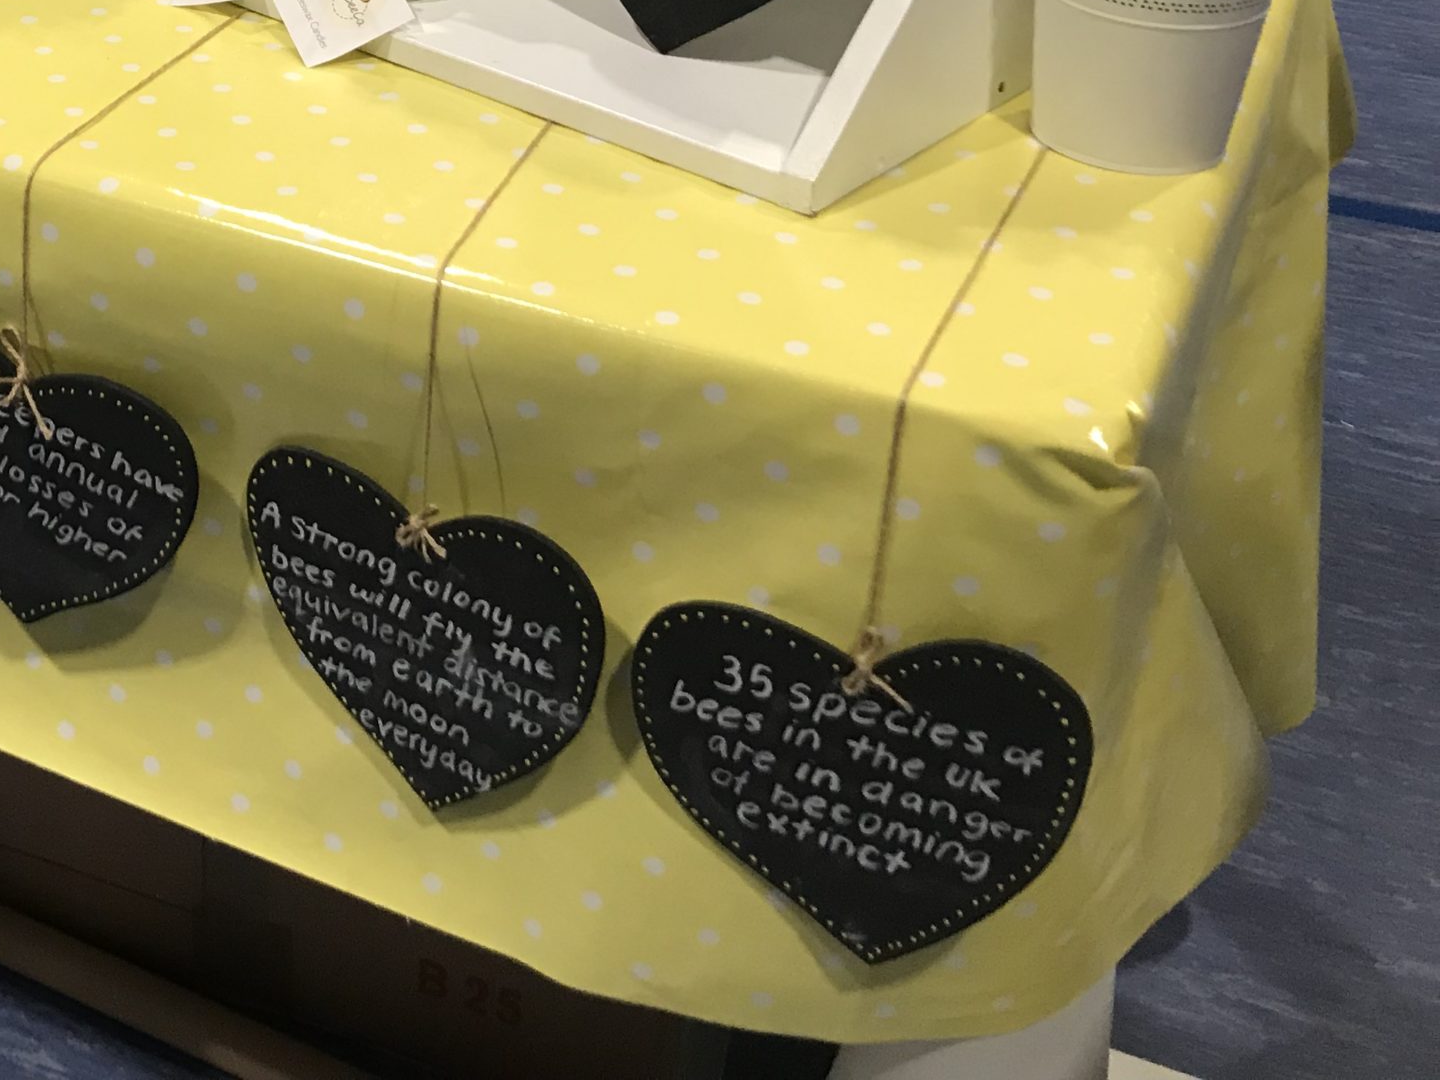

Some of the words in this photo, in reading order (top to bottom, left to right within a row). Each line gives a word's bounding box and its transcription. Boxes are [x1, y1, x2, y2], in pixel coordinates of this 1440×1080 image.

[28, 442, 139, 510] annual
[106, 516, 144, 542] of
[111, 450, 184, 503] have
[27, 501, 128, 565] higher
[260, 500, 281, 530] A
[289, 514, 398, 587] strong
[407, 570, 513, 638] colony
[522, 620, 562, 651] of
[271, 543, 336, 589] bees
[349, 581, 412, 620] will
[422, 611, 474, 662] fly
[491, 639, 557, 680] the
[272, 574, 435, 660] equivalent
[442, 649, 581, 728] distance
[306, 615, 377, 668] from
[391, 657, 494, 721] earth
[507, 707, 544, 739] to
[319, 656, 373, 694] the
[383, 688, 470, 747] moon
[712, 653, 774, 699] 35
[788, 681, 990, 756] species
[1002, 742, 1045, 776] of
[669, 678, 765, 733] bees
[781, 718, 822, 751] in
[845, 734, 927, 780] the
[944, 761, 1003, 803] UK
[706, 733, 777, 773] are
[794, 757, 842, 793] in
[861, 777, 1034, 842] danger
[710, 766, 752, 796] of
[770, 782, 993, 883] becoming
[736, 799, 913, 876] extinct
